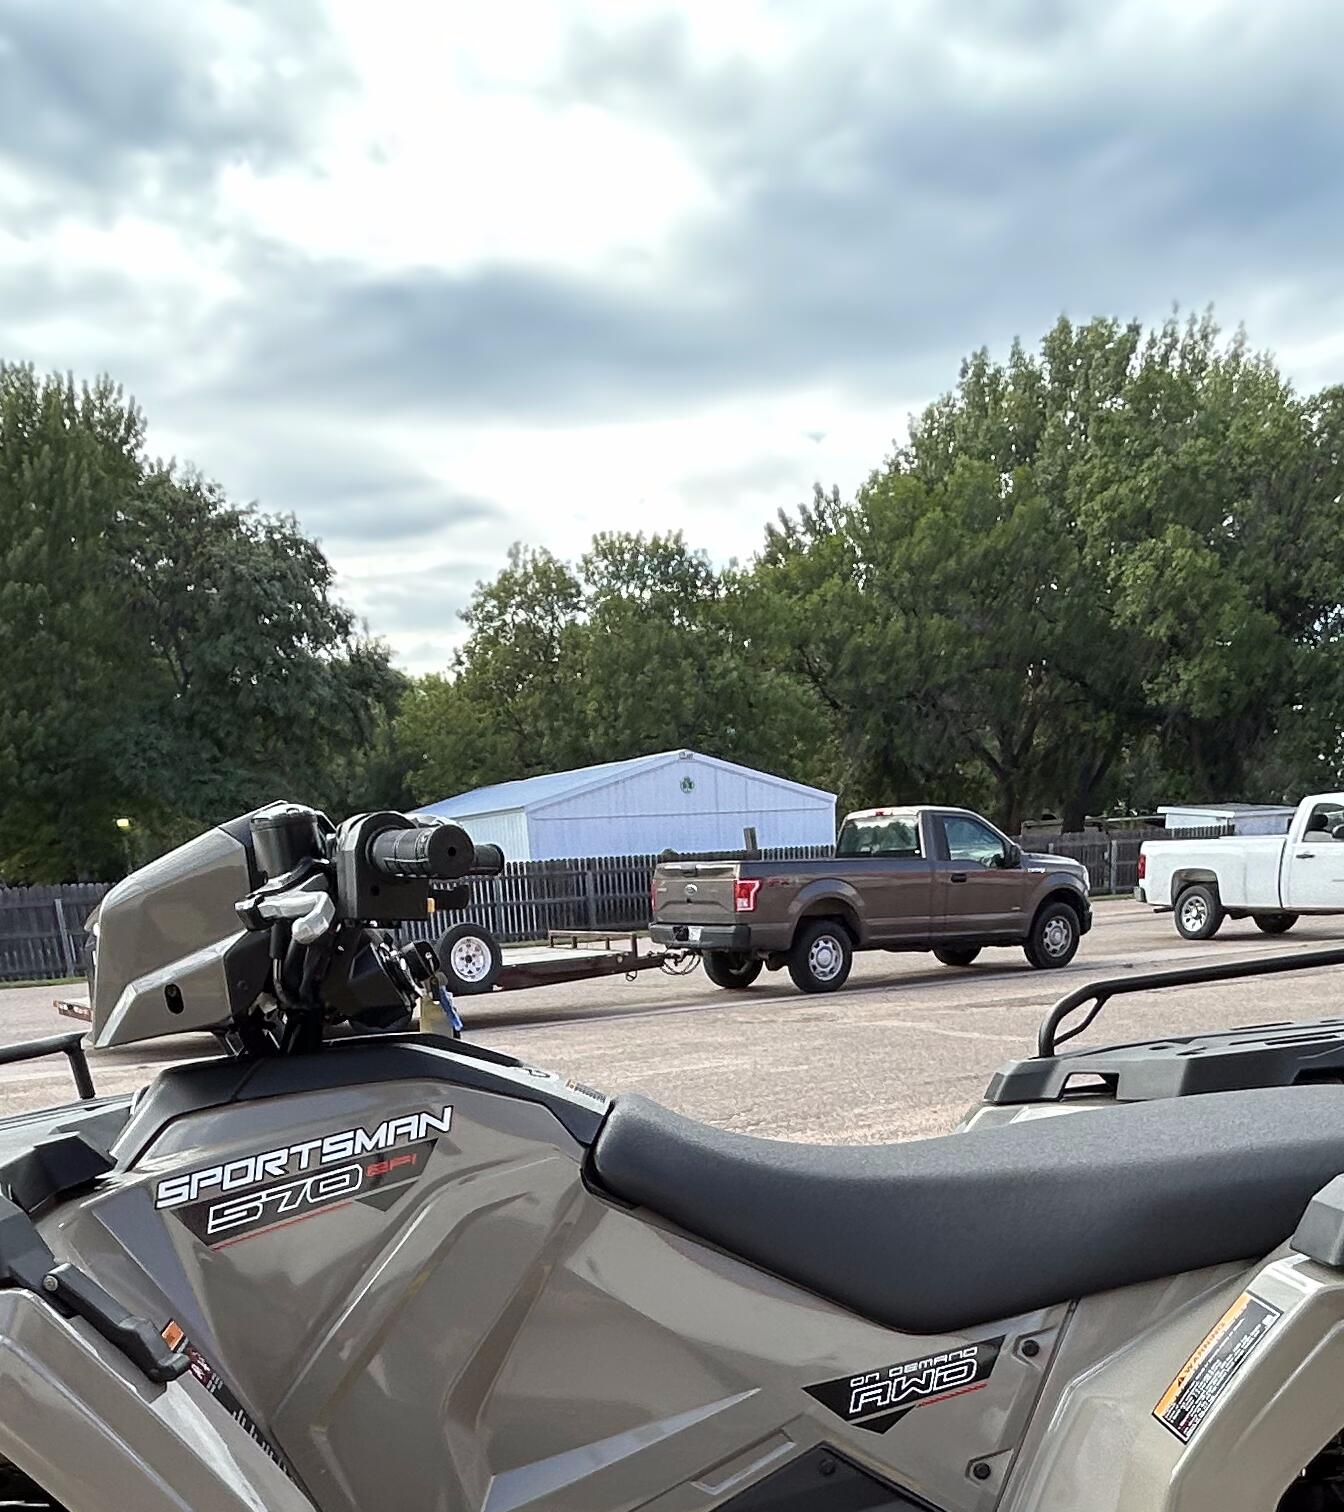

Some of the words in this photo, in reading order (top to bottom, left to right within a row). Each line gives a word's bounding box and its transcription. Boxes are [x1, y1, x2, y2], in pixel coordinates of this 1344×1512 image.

[156, 1105, 454, 1209] SPORTSMAN
[207, 1163, 363, 1234] 570
[366, 1153, 418, 1177] EFI
[849, 1358, 978, 1414] AWD
